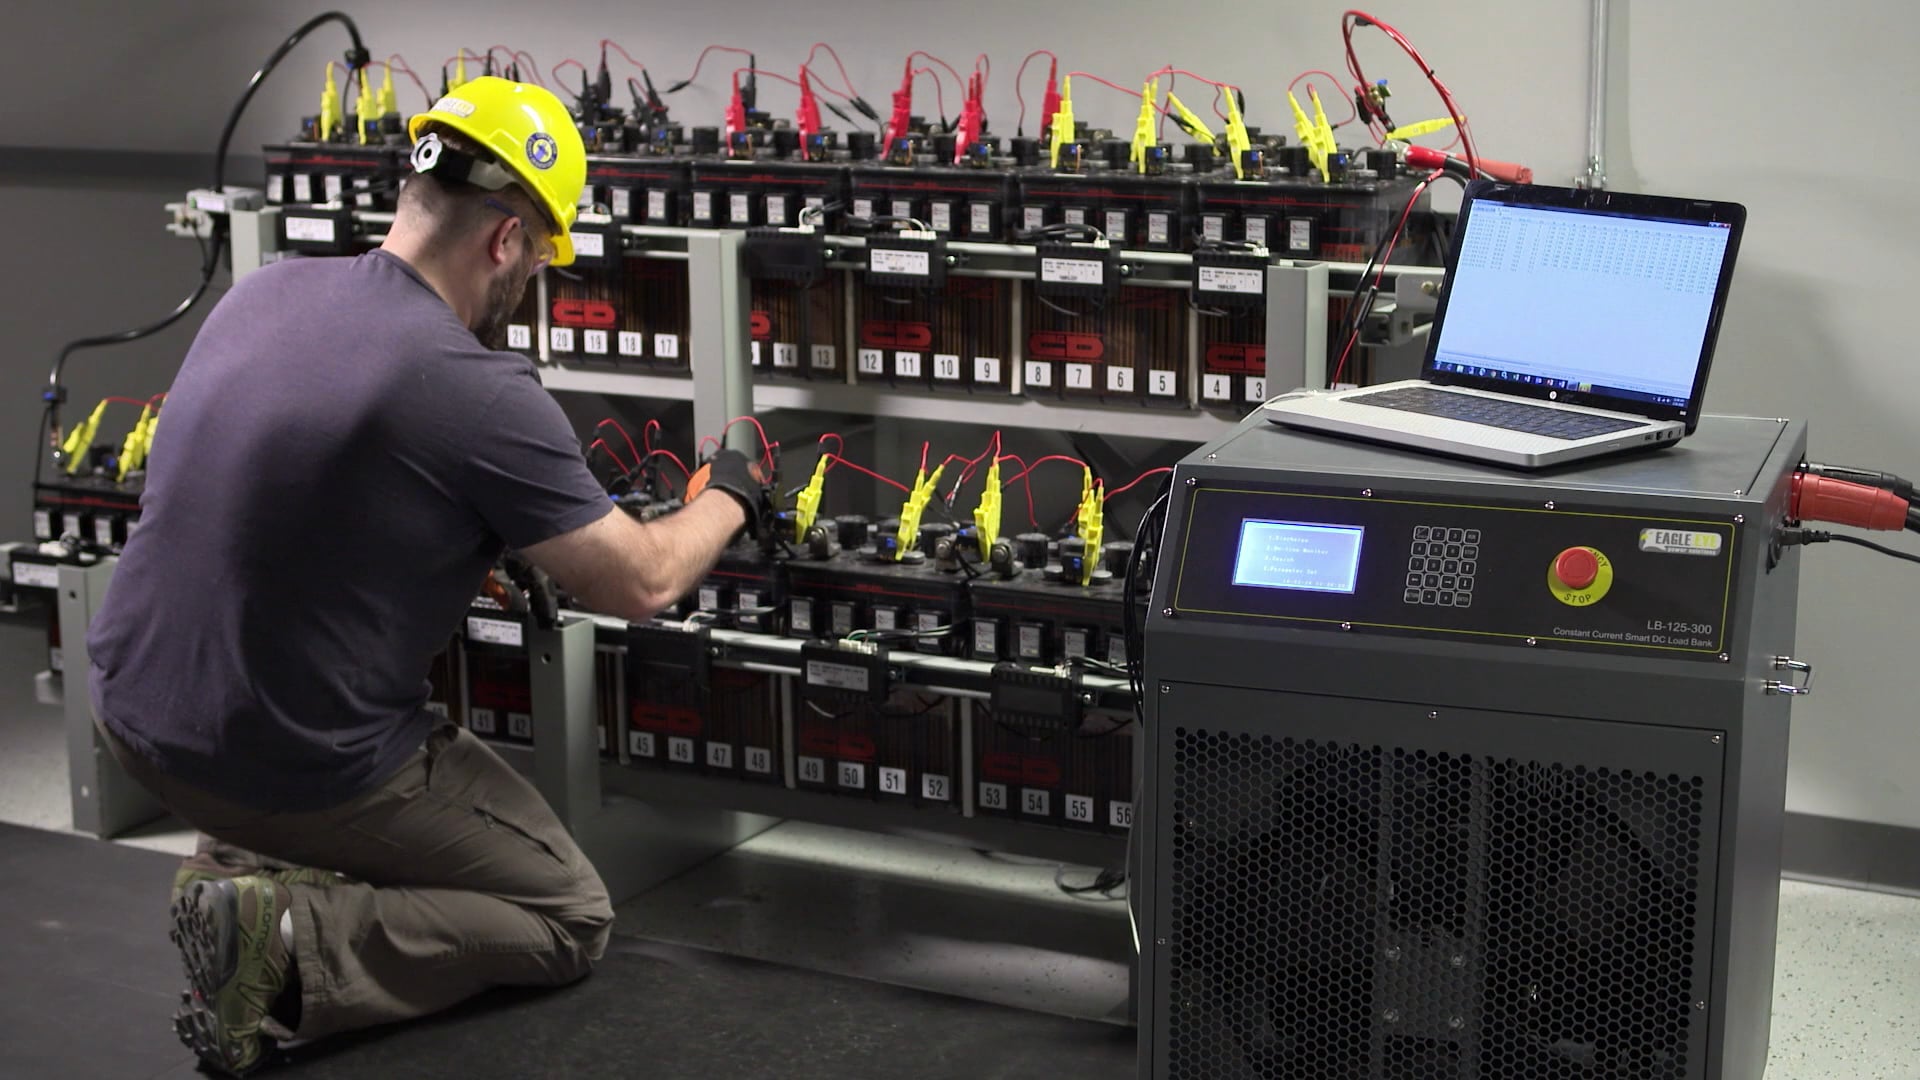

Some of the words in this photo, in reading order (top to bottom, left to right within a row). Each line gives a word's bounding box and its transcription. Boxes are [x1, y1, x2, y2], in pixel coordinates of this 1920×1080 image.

[513, 328, 524, 344] 21
[556, 332, 567, 347] 20
[591, 335, 601, 350] 19
[624, 336, 636, 352] 18
[660, 339, 672, 354] 17
[779, 347, 793, 362] 14
[818, 350, 829, 366] 13
[864, 354, 876, 369] 12
[903, 358, 913, 371] 11
[941, 360, 953, 375] 10
[1655, 531, 1692, 547] EAGLE
[1564, 593, 1591, 603] STOP
[1647, 620, 1712, 634] LB-125-300
[1553, 627, 1590, 638] Constant
[1592, 630, 1623, 640] Current
[1625, 633, 1650, 642] Smart
[1652, 635, 1665, 644] DC
[1667, 637, 1689, 645] Load
[1691, 639, 1713, 648] Bank
[636, 737, 648, 753] 45
[675, 744, 687, 759] 46
[713, 748, 725, 764] 47
[752, 753, 764, 769] 48
[805, 762, 818, 779] 49
[844, 767, 858, 784] 50
[886, 772, 898, 789] 51
[929, 781, 943, 796] 52
[986, 788, 1000, 805] 53
[1029, 794, 1042, 811] 54
[1071, 801, 1087, 818] 55
[1117, 806, 1131, 824] 56
